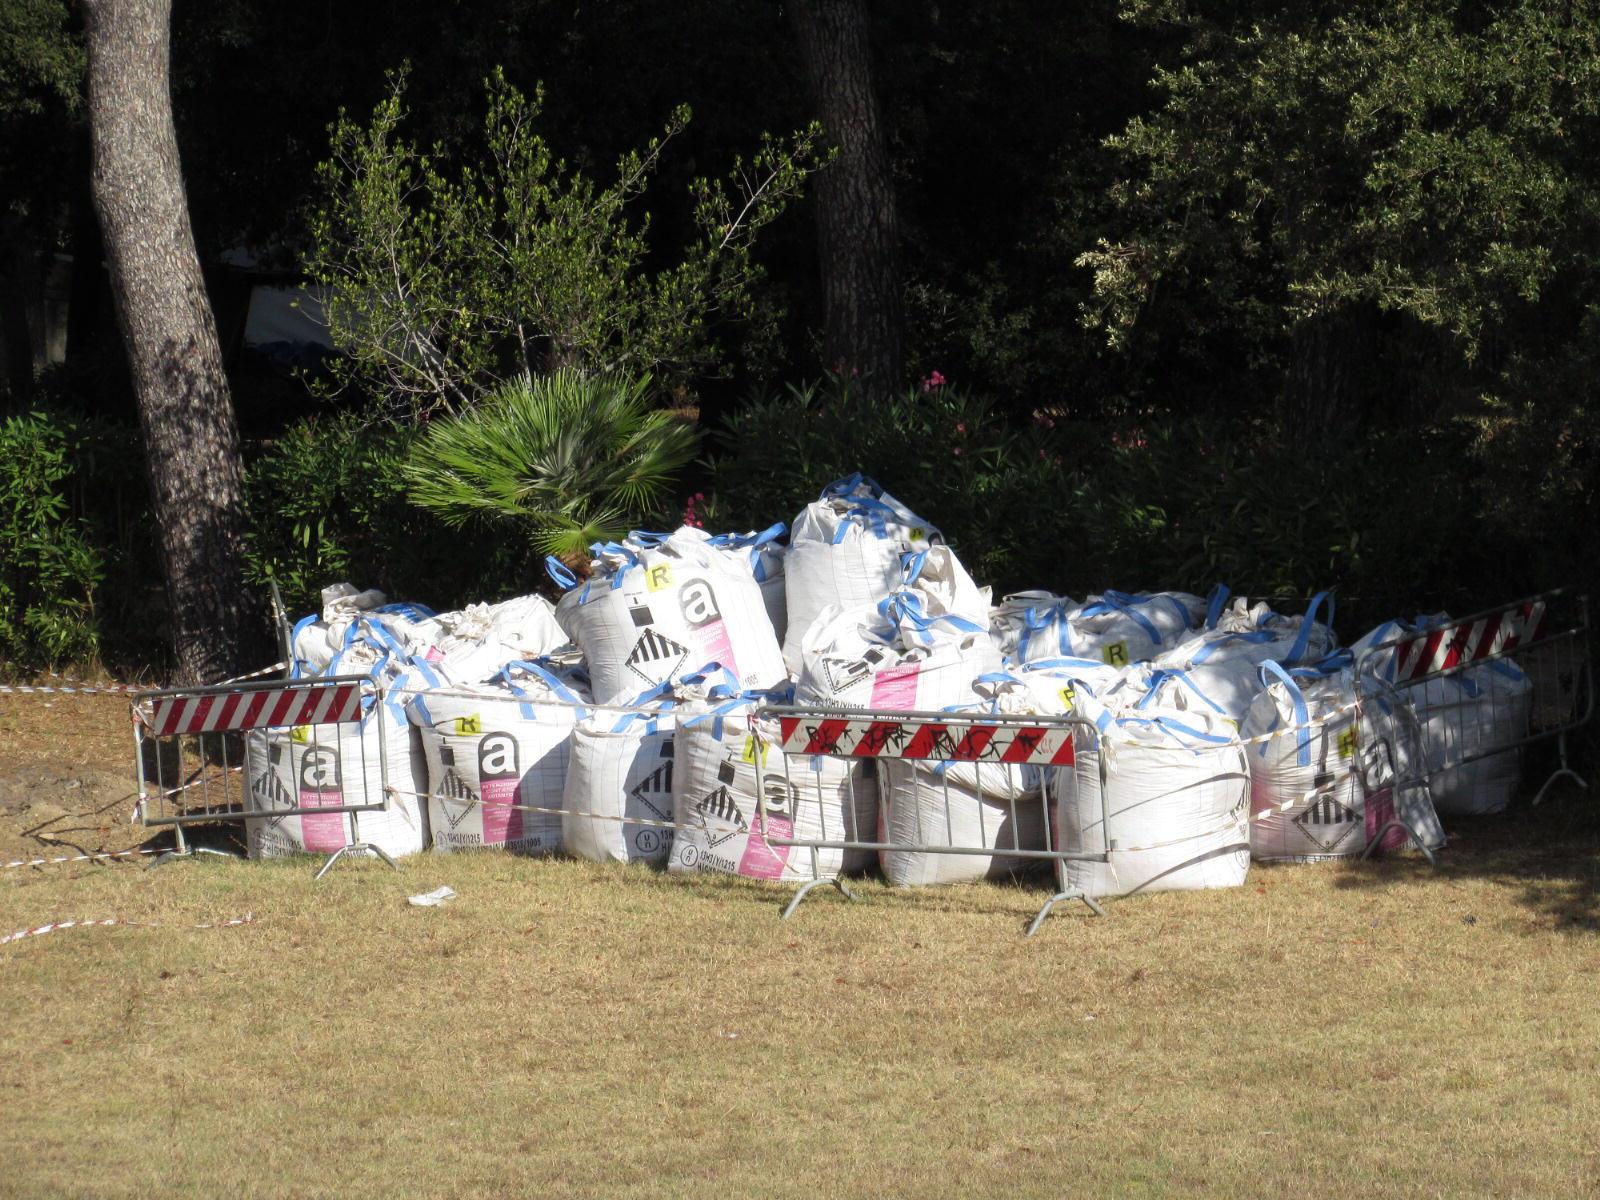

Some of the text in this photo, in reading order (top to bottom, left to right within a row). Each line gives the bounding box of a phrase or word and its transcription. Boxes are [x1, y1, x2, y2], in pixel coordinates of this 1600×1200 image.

[651, 567, 670, 587] R
[682, 582, 718, 624] a
[1109, 643, 1124, 661] R
[303, 749, 338, 787] a
[482, 737, 517, 775] a
